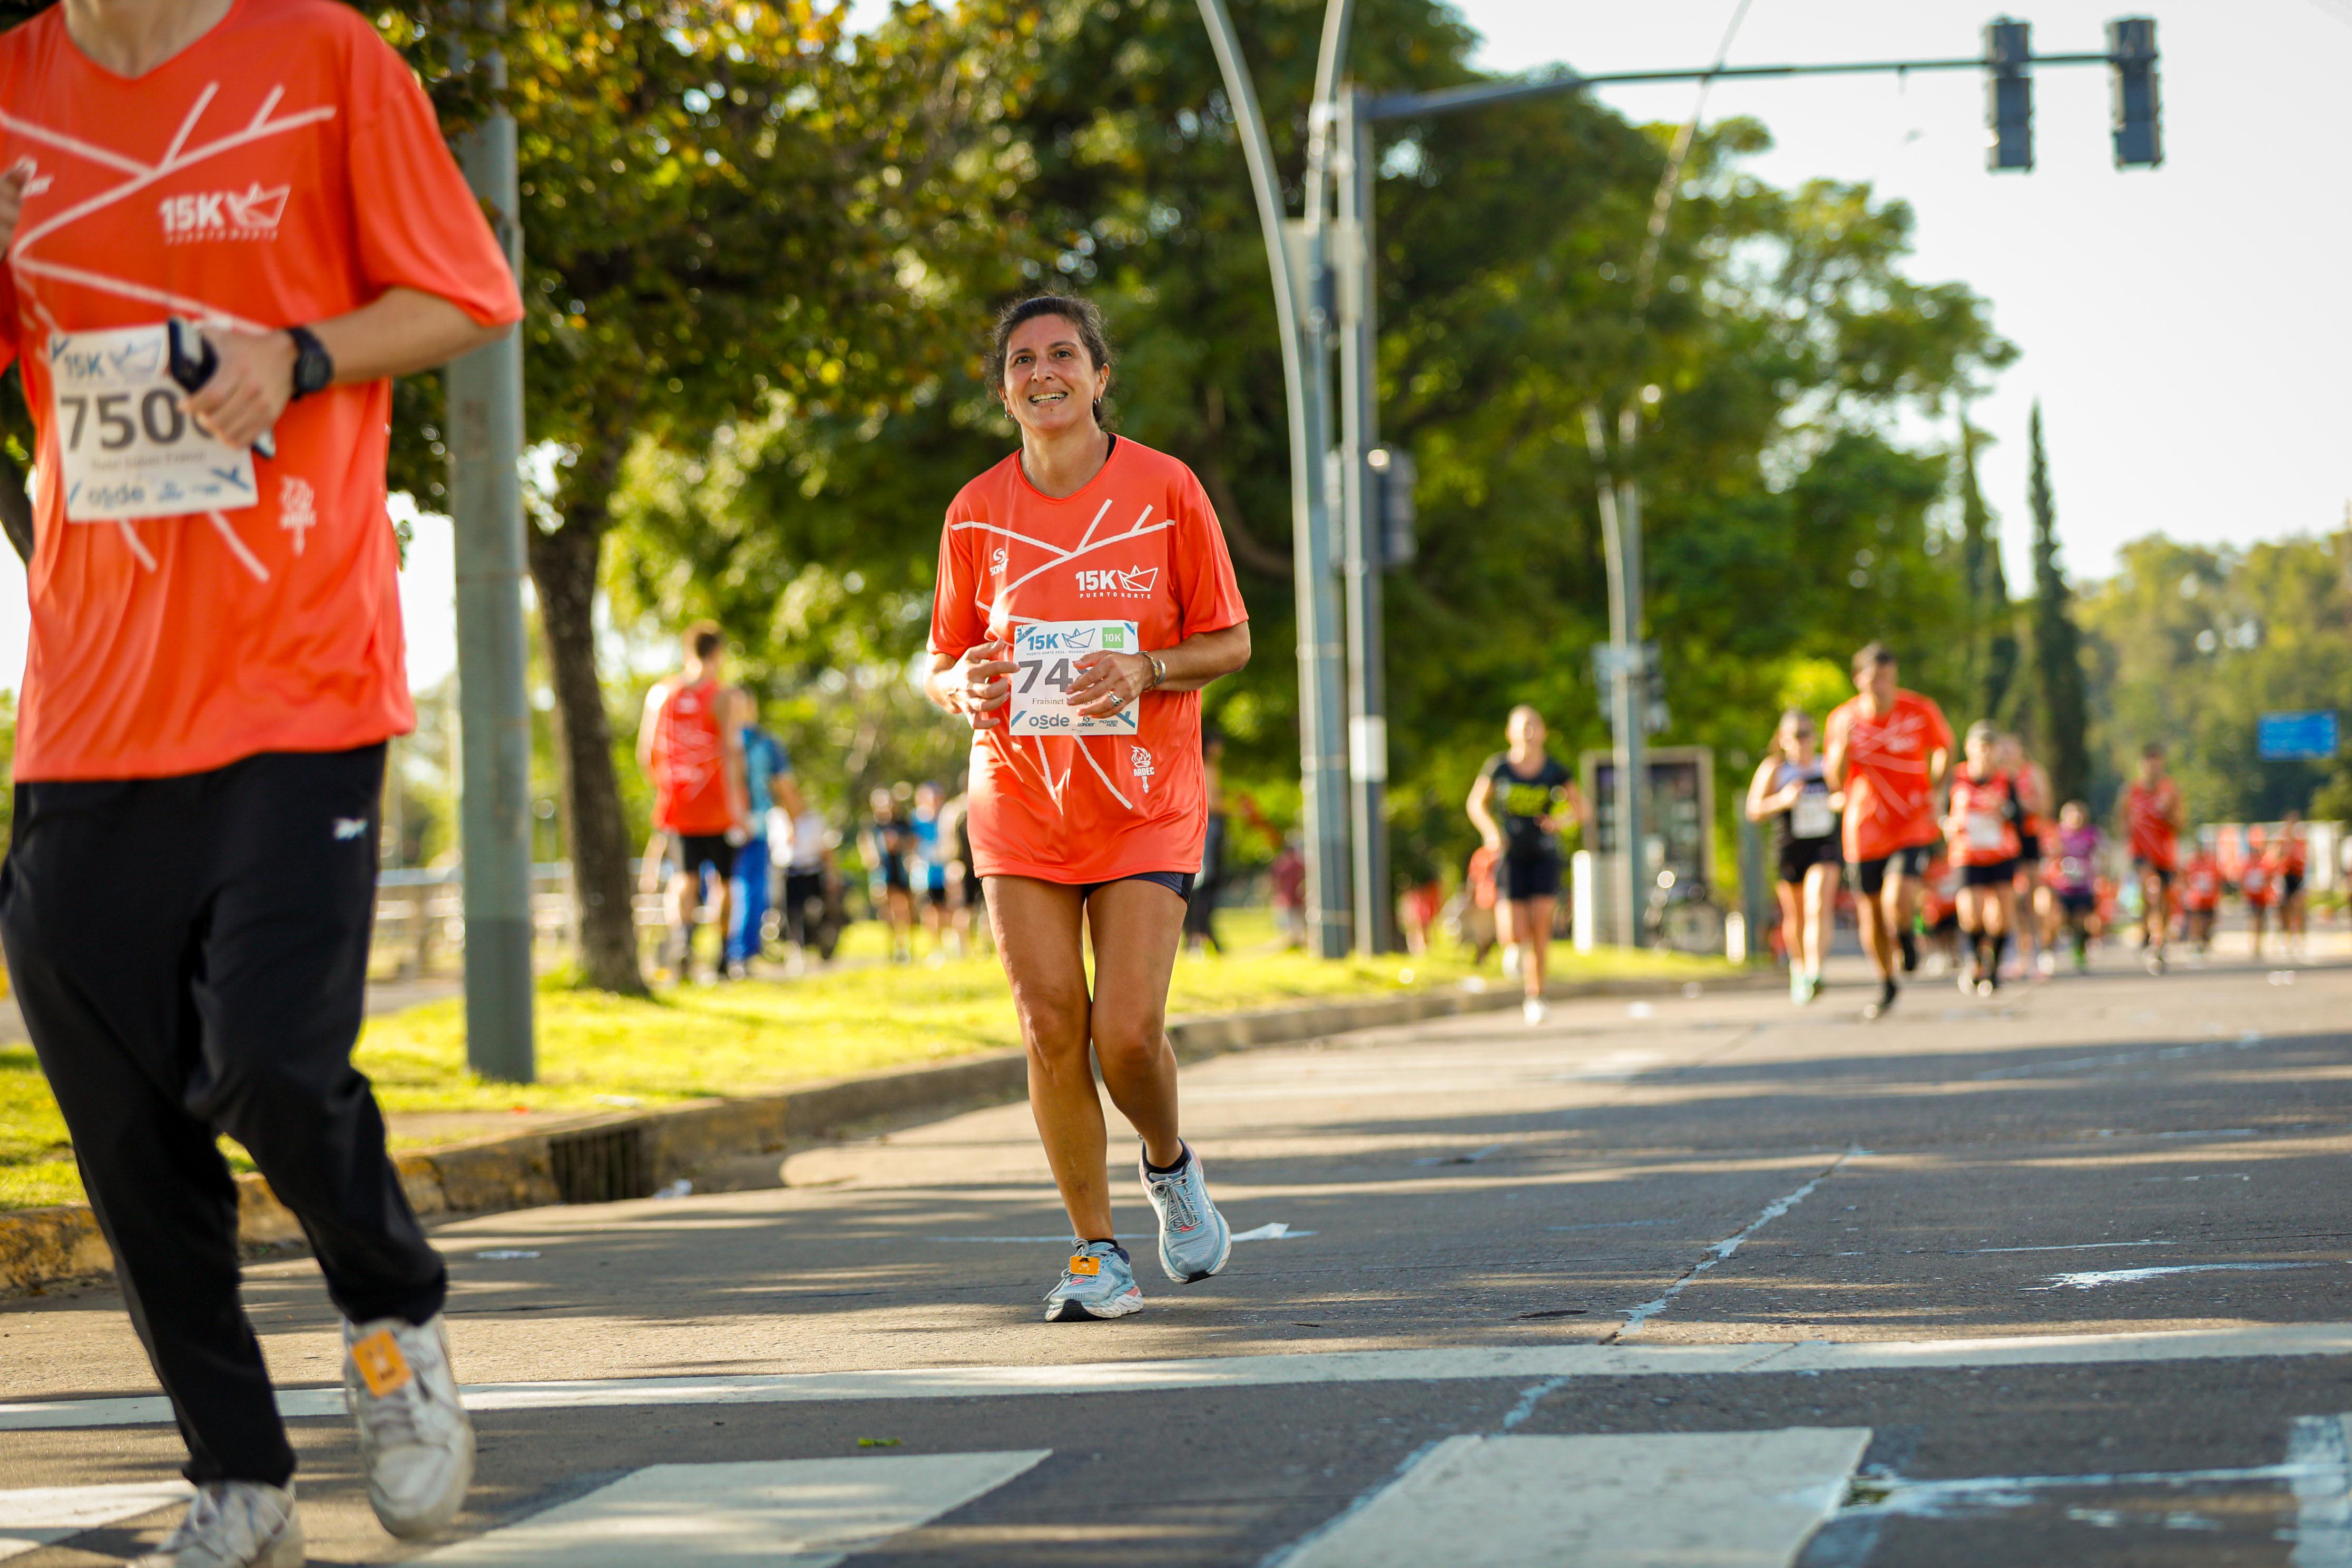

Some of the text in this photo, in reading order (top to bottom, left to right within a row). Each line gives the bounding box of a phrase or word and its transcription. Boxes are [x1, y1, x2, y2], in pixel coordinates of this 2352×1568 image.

[160, 192, 226, 232] 15K
[64, 351, 104, 380] 15K
[1075, 570, 1117, 591] 15K
[1027, 633, 1059, 651] 15K
[1104, 633, 1122, 642] 10K
[1028, 713, 1070, 728] osde
[1133, 767, 1155, 777] ARDEC
